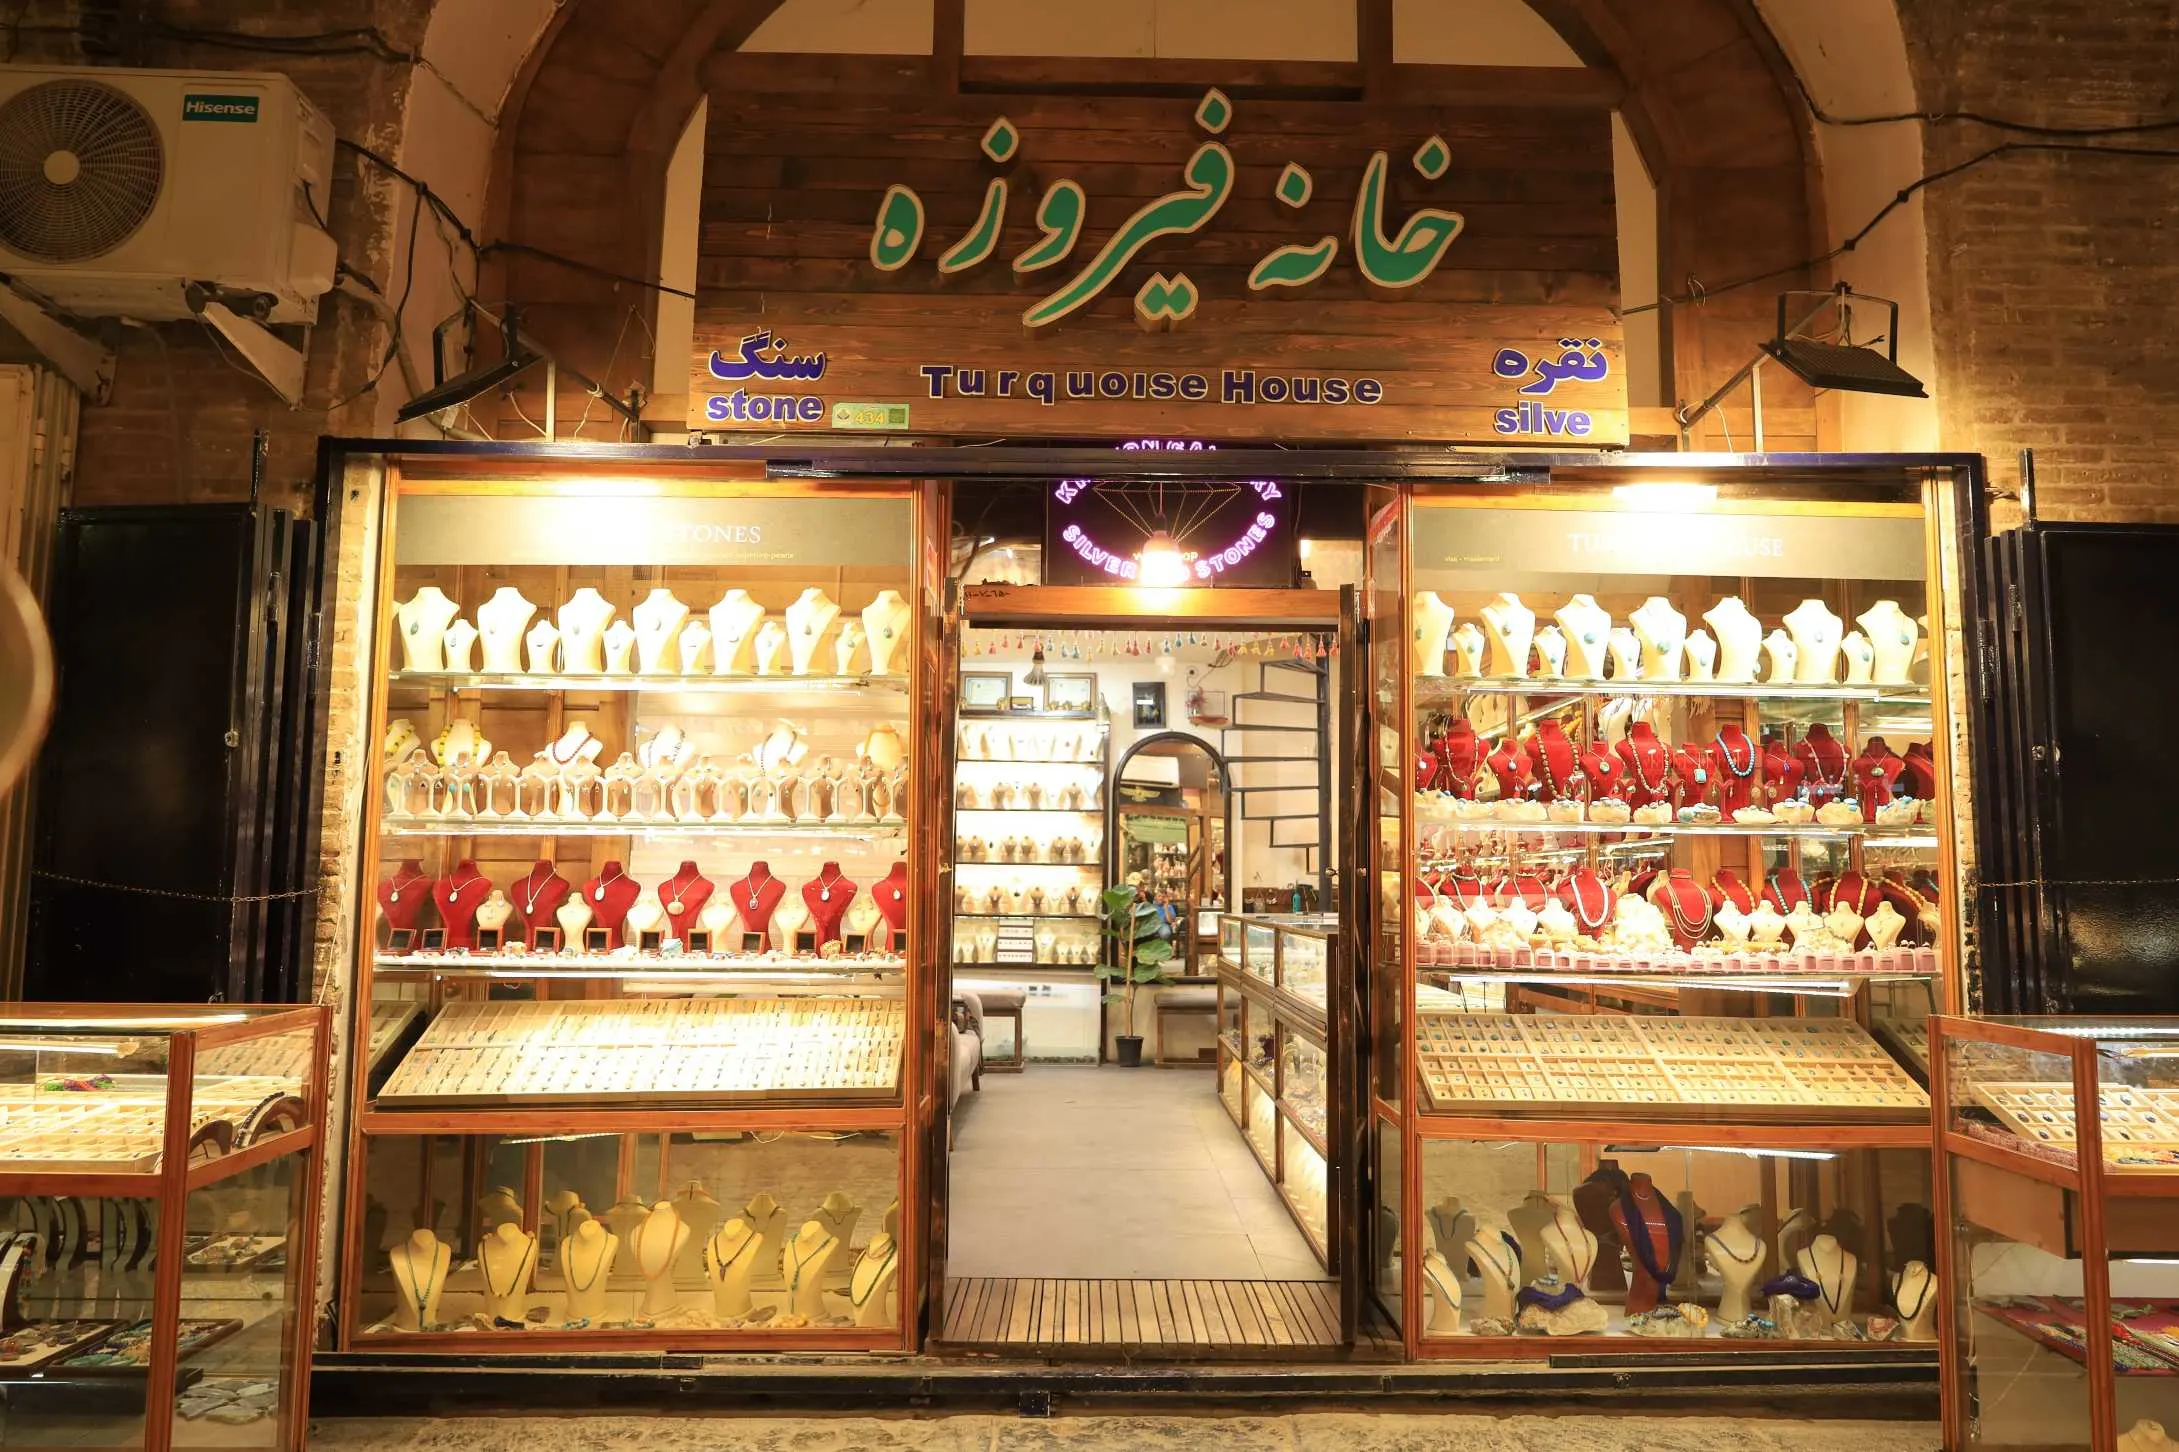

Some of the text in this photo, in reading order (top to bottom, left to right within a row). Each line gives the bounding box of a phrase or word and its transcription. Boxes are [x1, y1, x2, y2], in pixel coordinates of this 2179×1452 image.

[186, 100, 256, 115] Hisense
[869, 87, 1465, 331] خانه فیروزه
[708, 329, 826, 382] سنگ
[1493, 337, 1609, 395] نقره
[706, 387, 824, 422] stone
[1220, 369, 1384, 405] House
[855, 410, 885, 425] 434
[1494, 400, 1592, 437] silve
[1062, 511, 1276, 580] SILVER STONES
